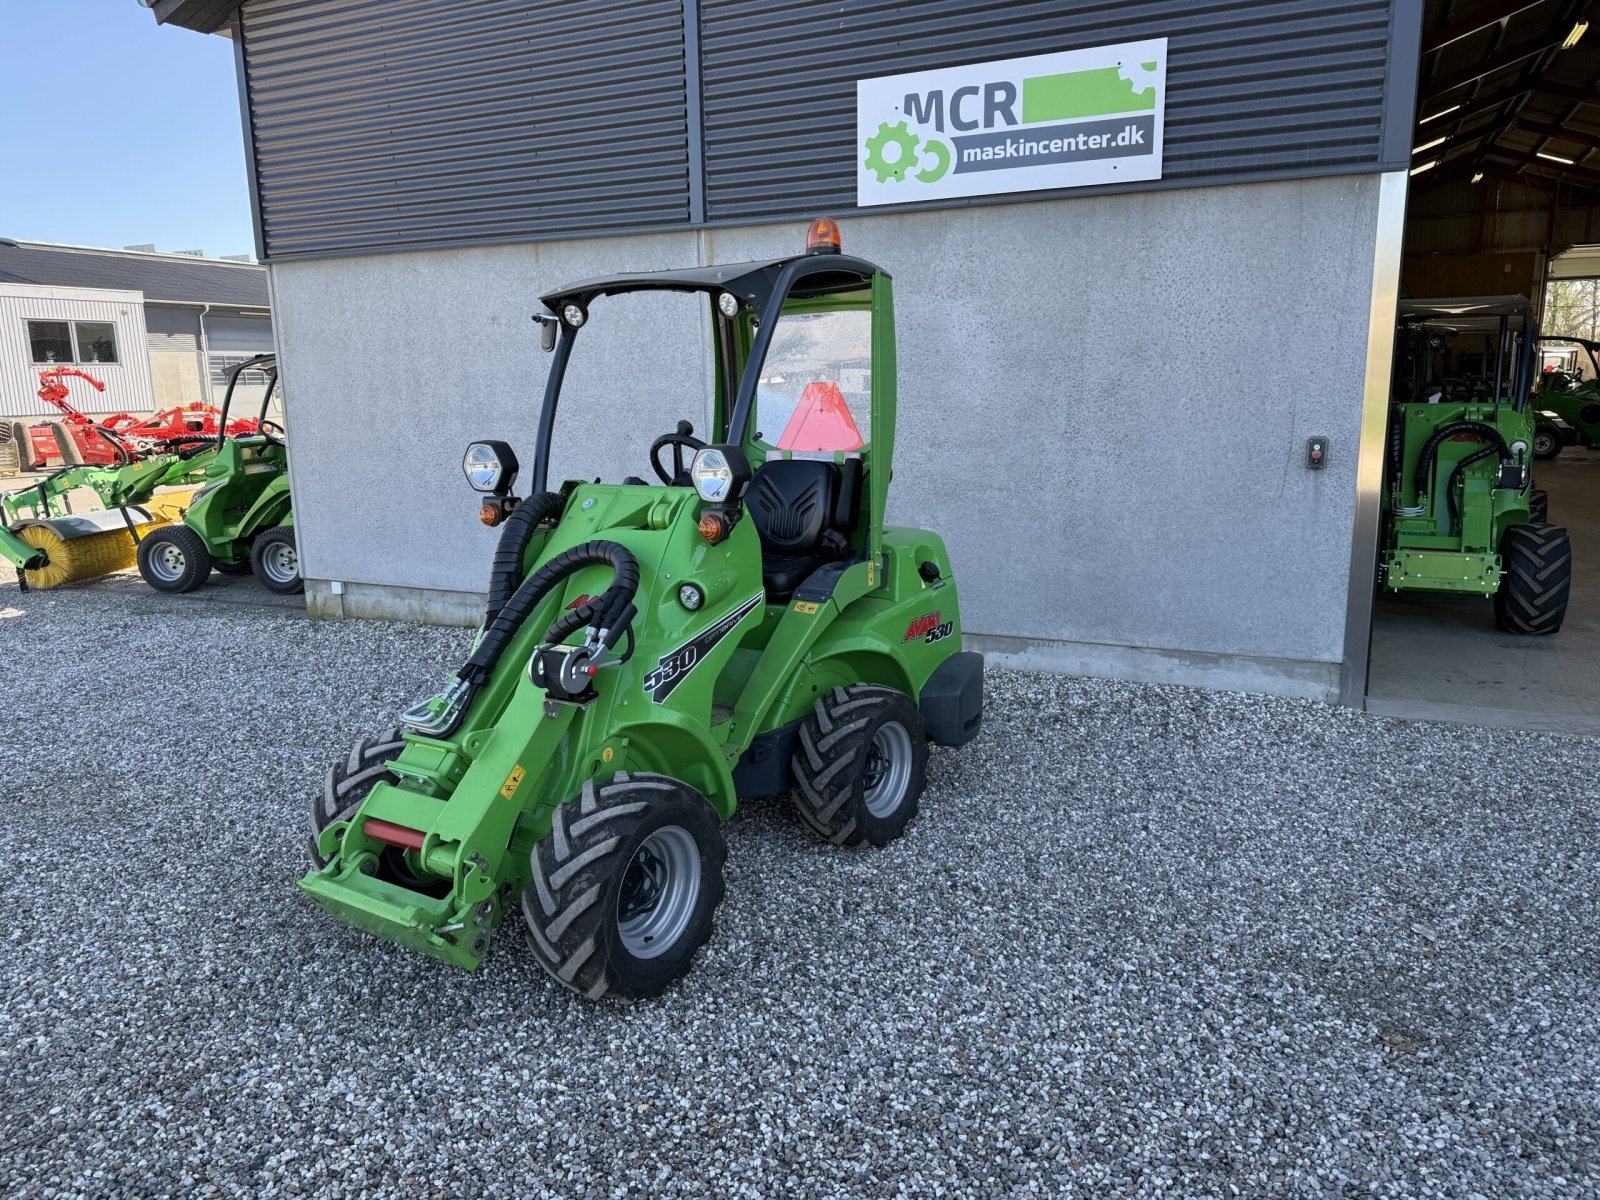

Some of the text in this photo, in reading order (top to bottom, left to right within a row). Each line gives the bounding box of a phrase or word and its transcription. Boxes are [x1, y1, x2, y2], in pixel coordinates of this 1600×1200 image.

[903, 81, 1019, 133] MCR
[963, 124, 1145, 163] maskincenter.dk
[925, 621, 954, 645] 530
[643, 645, 697, 693] 530
